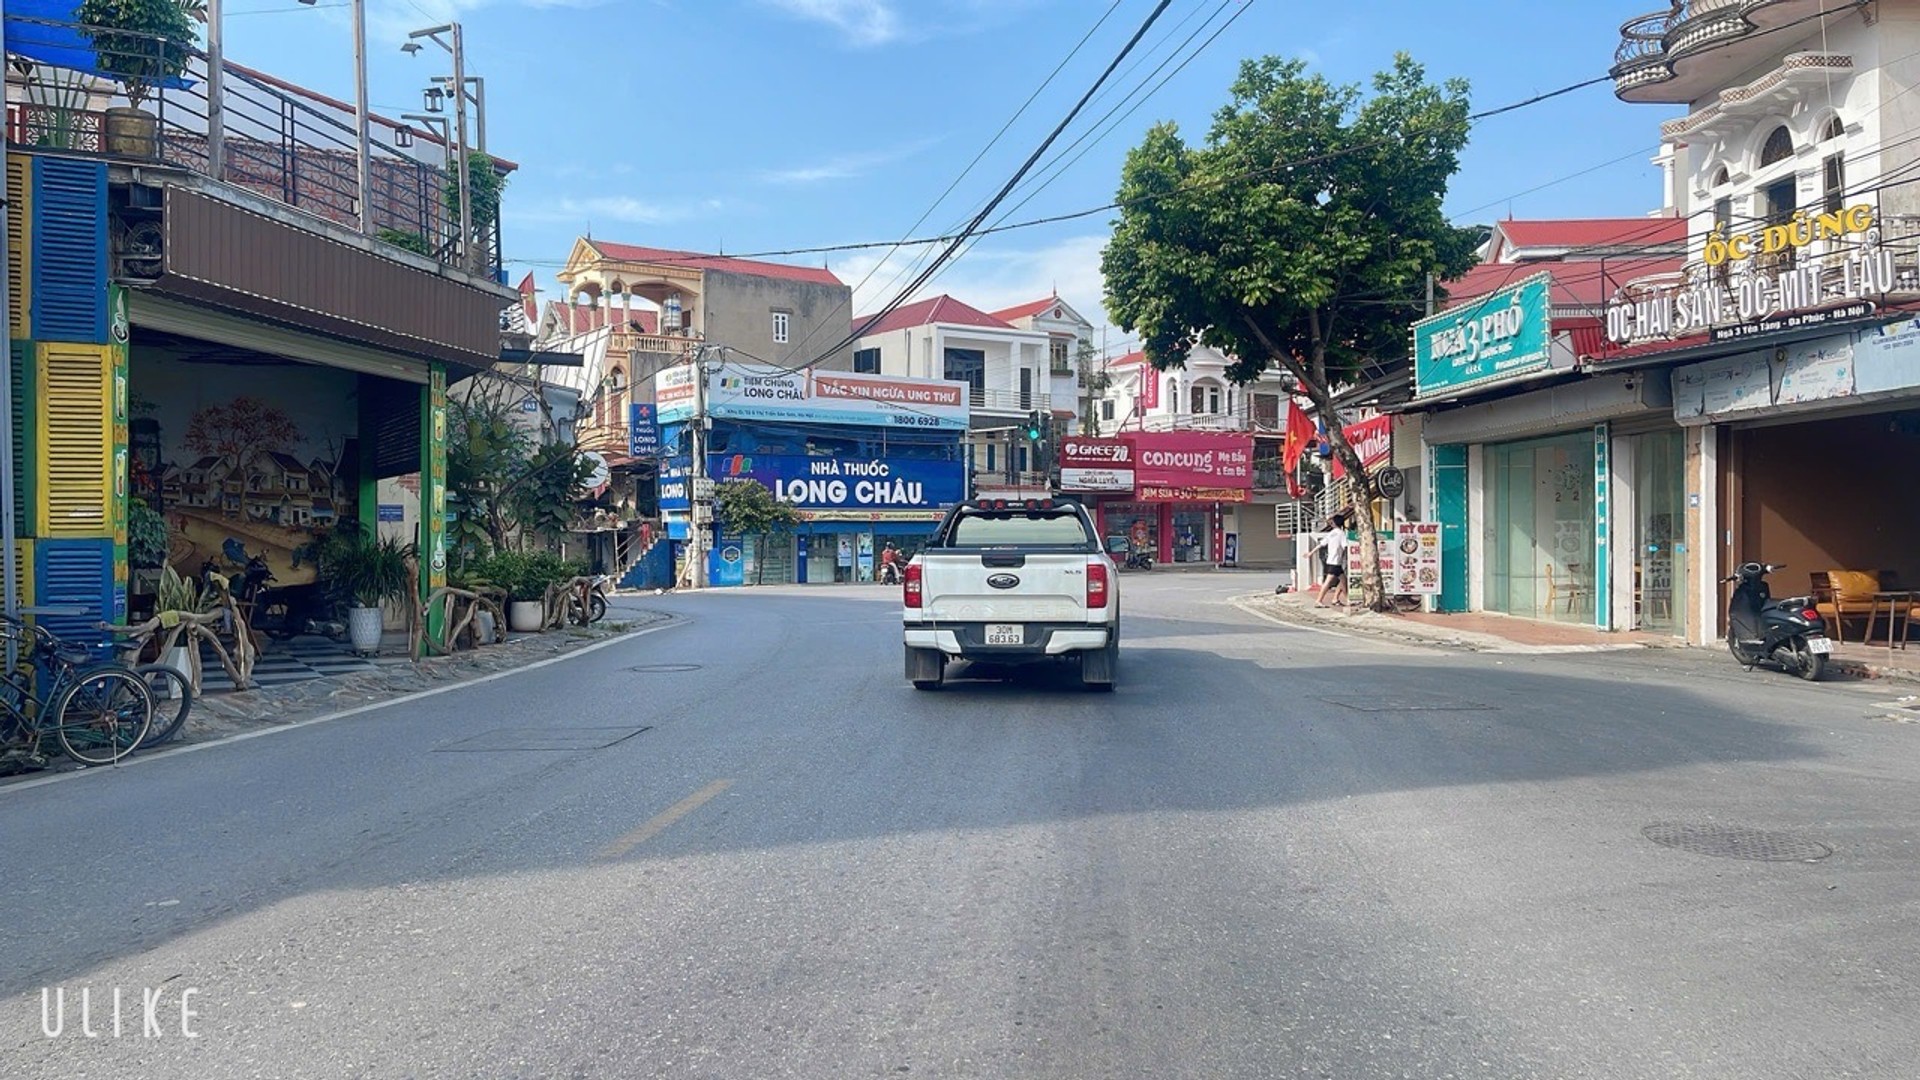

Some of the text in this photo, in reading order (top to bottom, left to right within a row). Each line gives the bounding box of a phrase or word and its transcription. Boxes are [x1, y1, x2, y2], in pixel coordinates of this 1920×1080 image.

[1703, 203, 1873, 266] ỐC DŨNG
[1467, 320, 1480, 363] 3
[1481, 287, 1524, 344] PHỐ
[743, 387, 774, 399] LONG
[849, 385, 870, 396] XIN
[872, 385, 905, 399] NGỪA
[907, 391, 931, 401] UNG
[933, 391, 957, 402] THƯ
[893, 415, 915, 425] 1800
[917, 416, 940, 427] 6928
[634, 436, 656, 444] LONG
[811, 459, 889, 477] NHÀ THUỐC
[775, 477, 923, 505] LONG CHÂU
